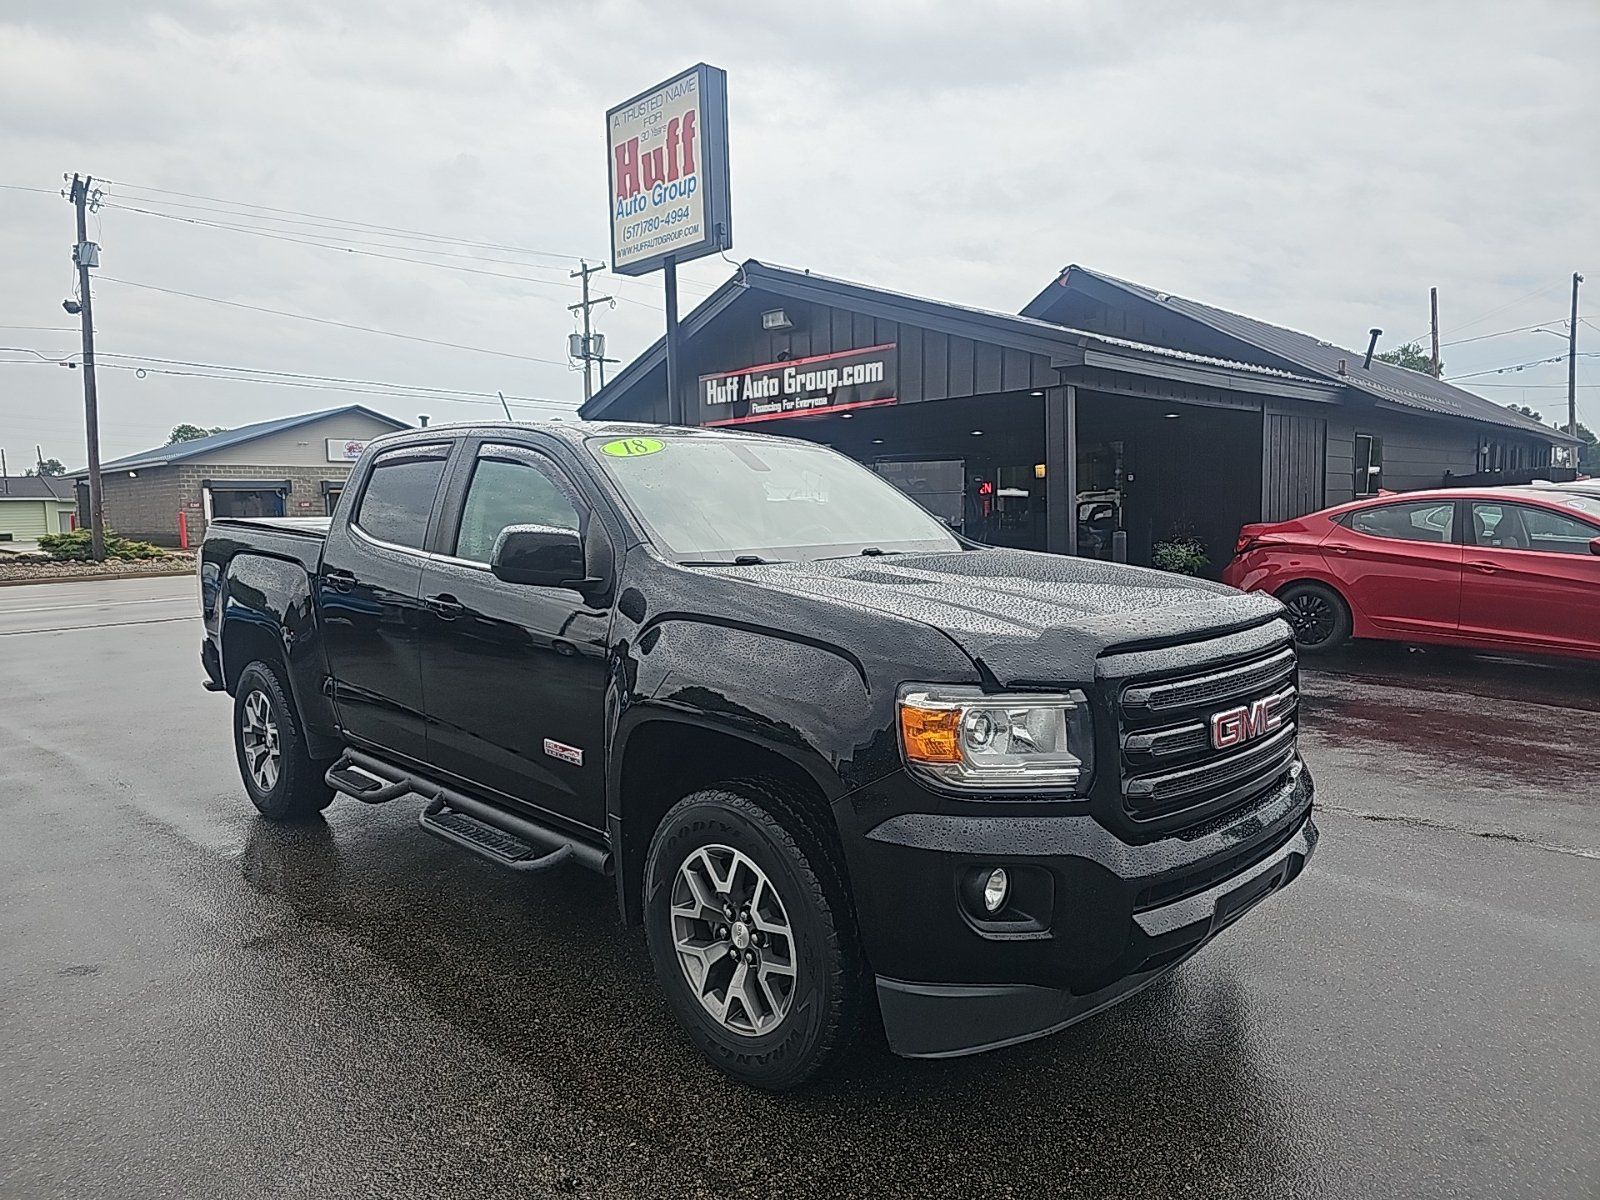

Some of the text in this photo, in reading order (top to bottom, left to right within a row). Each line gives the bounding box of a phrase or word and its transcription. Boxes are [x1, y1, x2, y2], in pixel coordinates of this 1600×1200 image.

[614, 76, 696, 128] A TRUSTED NAME
[643, 111, 663, 127] FOR
[614, 109, 696, 200] Huff
[640, 130, 650, 142] 30
[615, 176, 697, 220] Auto Group
[616, 224, 700, 258] WWW.HUFFAUTOGROUP.COM
[623, 205, 690, 242] (517)780-4994
[706, 361, 884, 405] Huff Auto Group.com
[782, 399, 795, 411] For
[620, 440, 648, 454] 18
[1210, 694, 1281, 749] GMC
